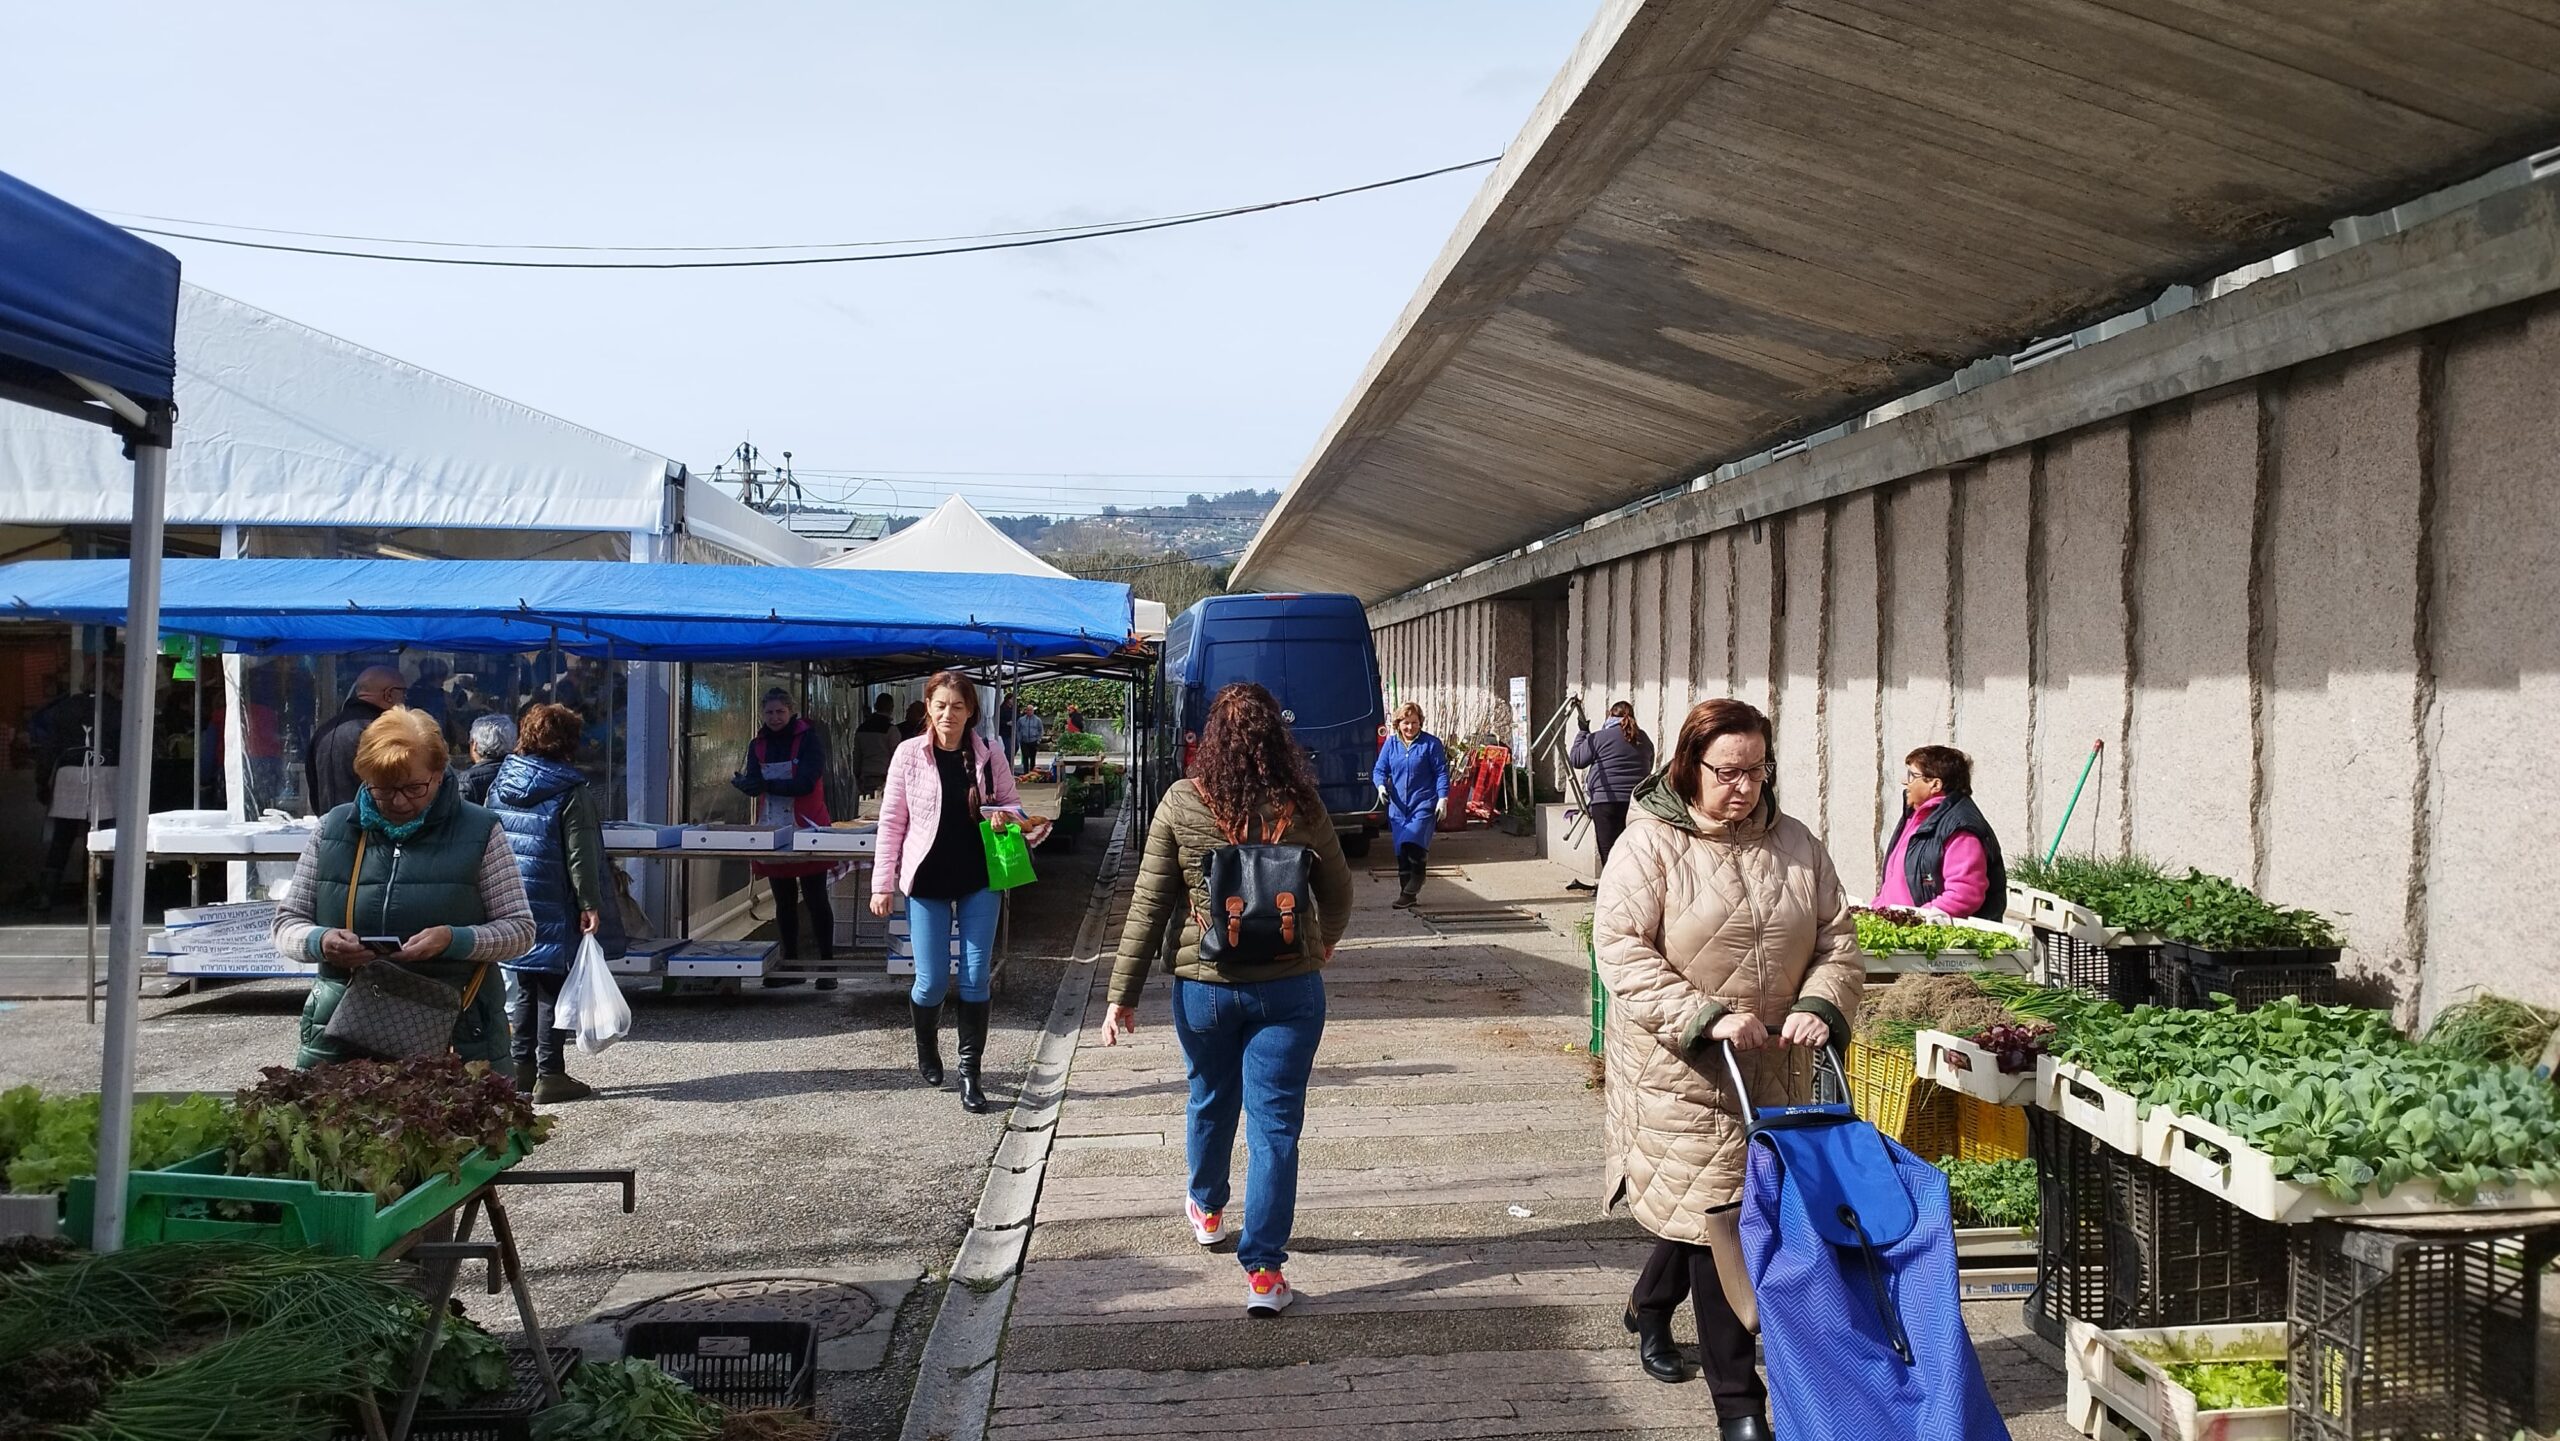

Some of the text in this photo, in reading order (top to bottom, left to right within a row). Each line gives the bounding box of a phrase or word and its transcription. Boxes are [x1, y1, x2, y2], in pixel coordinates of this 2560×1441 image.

[200, 964, 285, 972] SECADERO SANTA EULALIA
[2333, 1372, 2342, 1417] ALBERTO
